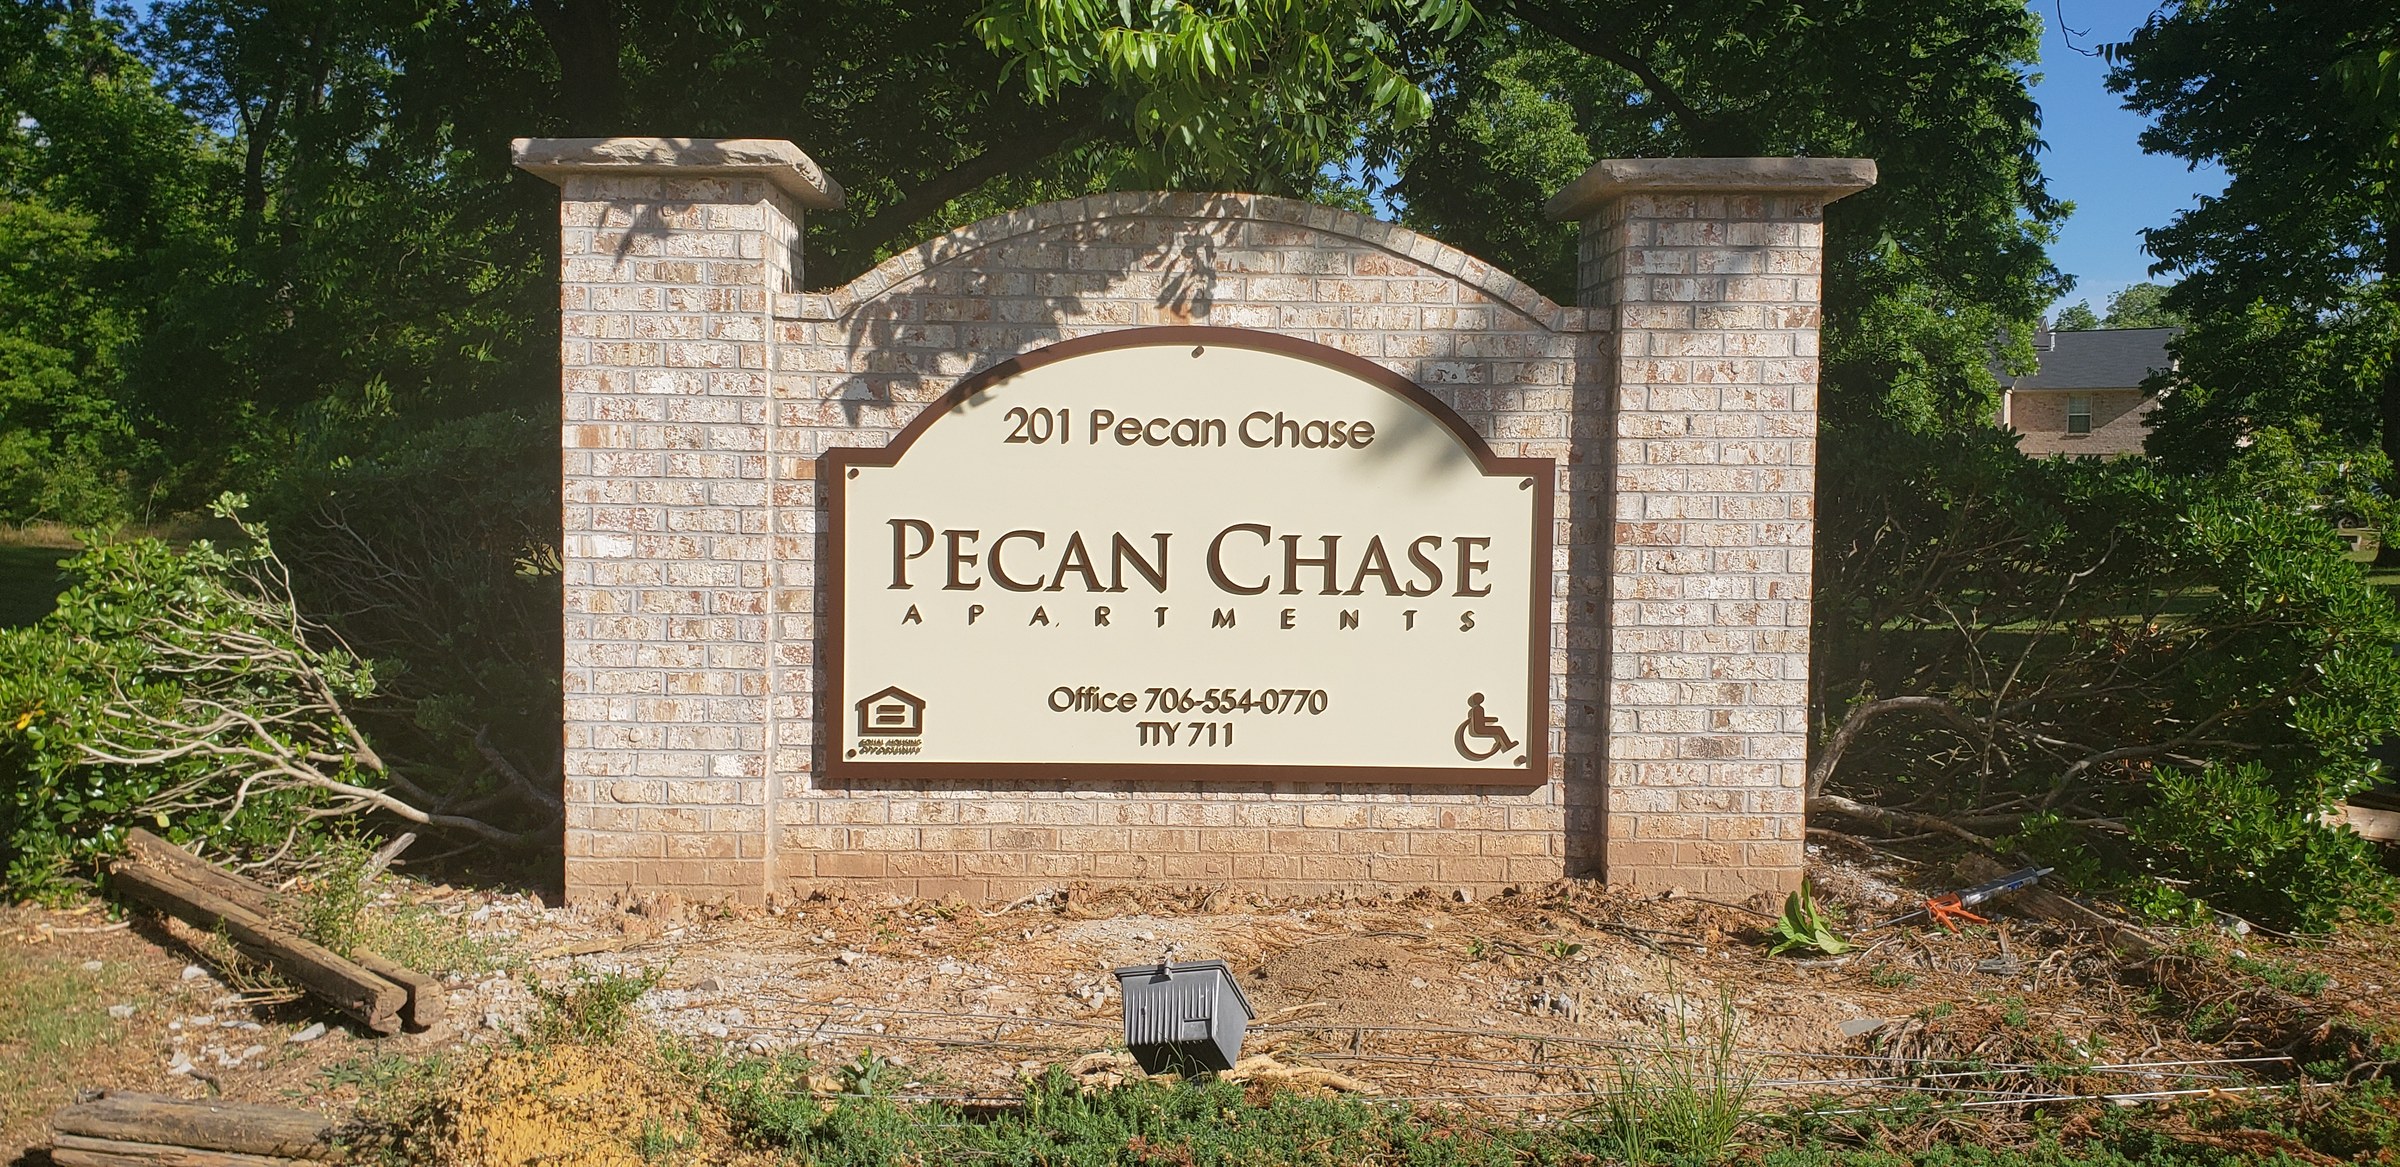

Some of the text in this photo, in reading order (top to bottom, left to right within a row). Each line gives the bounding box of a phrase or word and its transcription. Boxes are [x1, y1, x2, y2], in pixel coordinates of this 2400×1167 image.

[1003, 406, 1375, 450] 201 Pecan Chase
[886, 518, 1492, 598] PECAN CHASE
[1047, 685, 1328, 716] Office 706-554-0770
[1136, 721, 1234, 748] TTY 711
